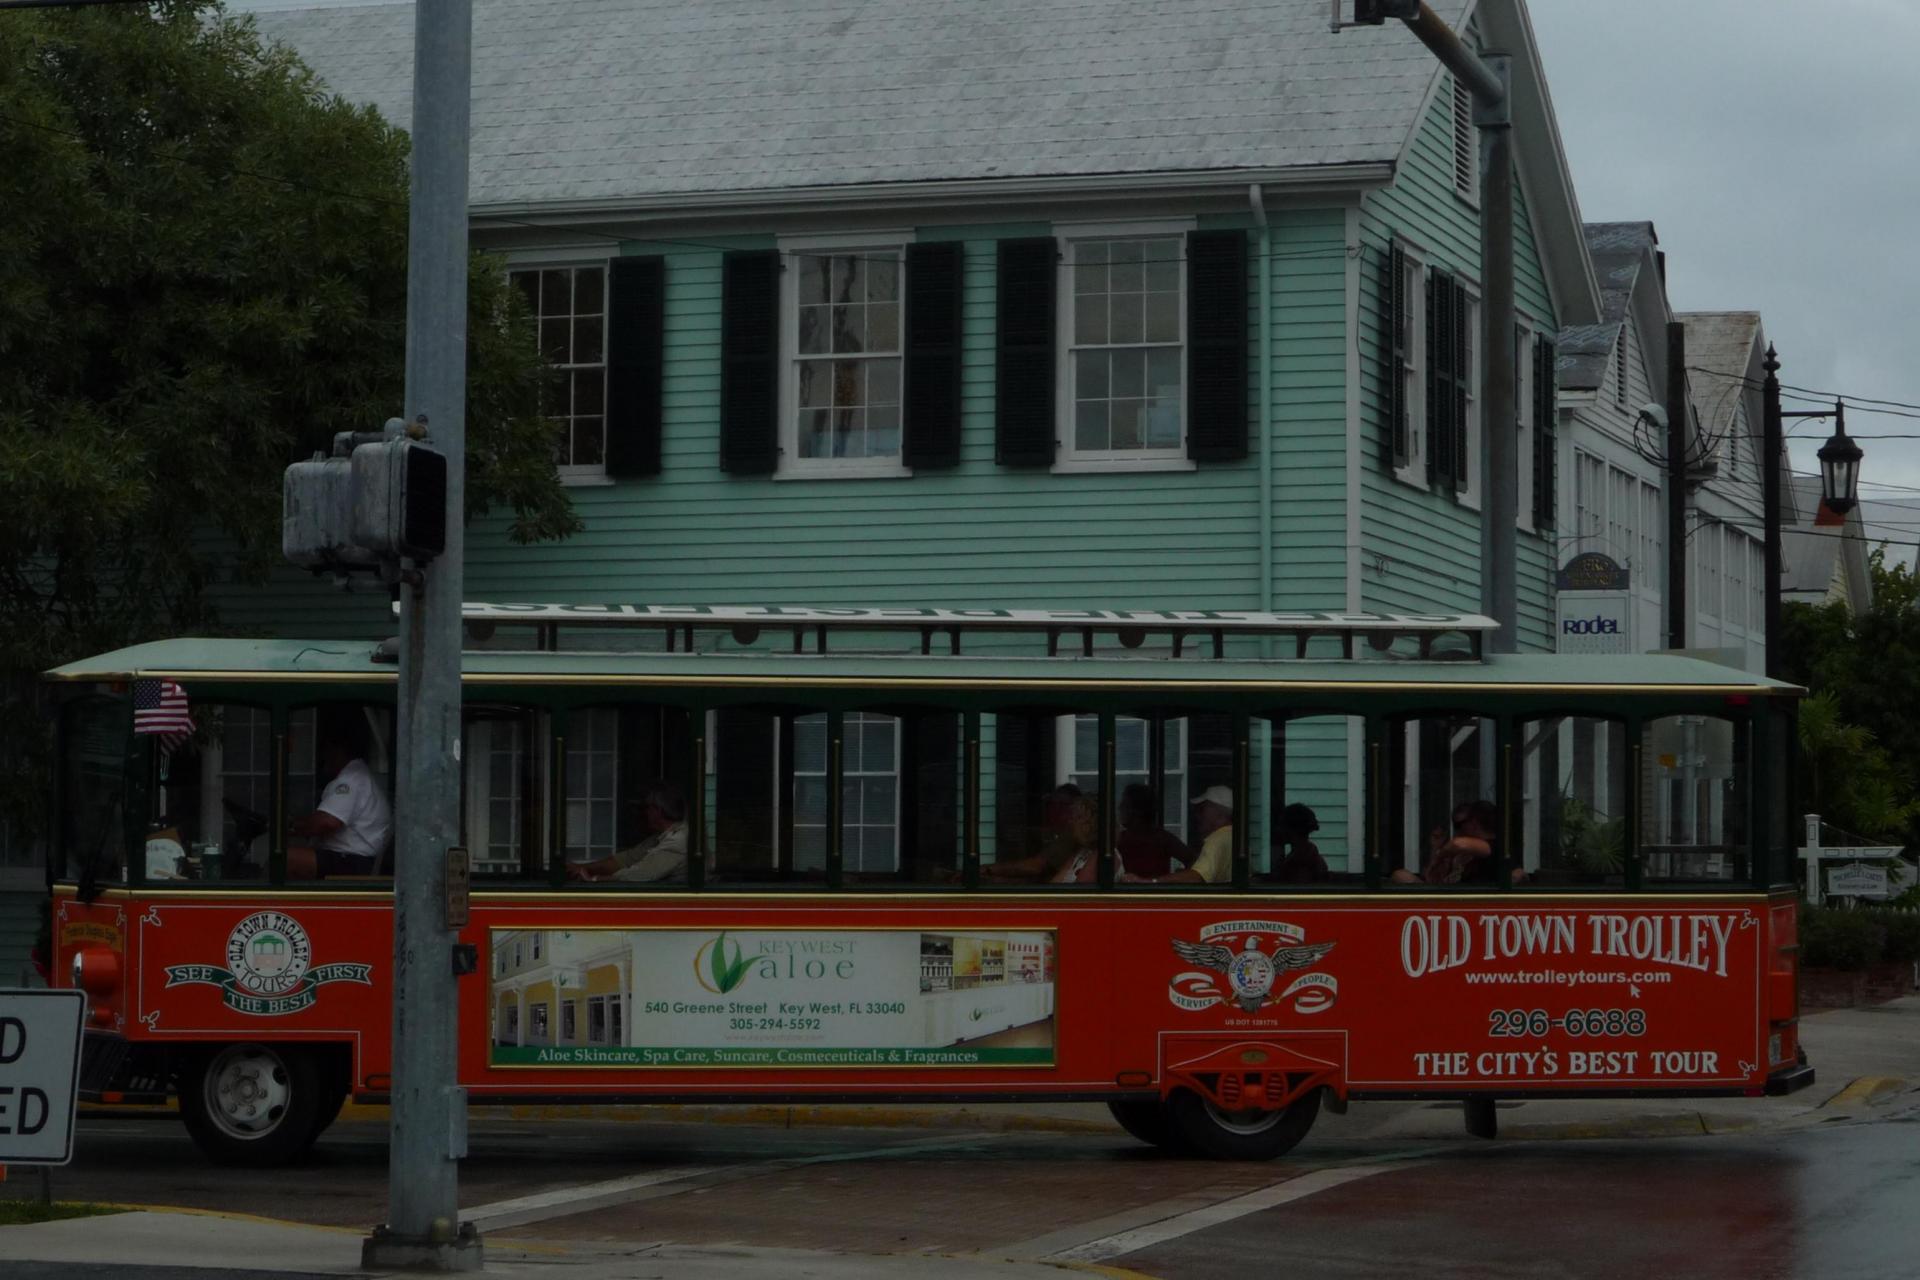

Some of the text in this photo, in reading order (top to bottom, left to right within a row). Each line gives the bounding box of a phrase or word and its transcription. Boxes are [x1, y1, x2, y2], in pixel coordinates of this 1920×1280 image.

[1214, 922, 1289, 934] ENTERTAINMENT
[230, 915, 308, 962] OLD TOWN TROLLEY
[1401, 915, 1737, 977] OLD TOWN TROLLEY
[176, 967, 213, 981] SEE
[316, 966, 366, 980] FIRST
[759, 955, 855, 979] aloe
[240, 968, 298, 992] TOURS
[1298, 975, 1329, 986] PEOPLE
[1465, 968, 1671, 988] www.trolleytours.com
[227, 992, 262, 1012] THE
[645, 1002, 905, 1017] 540 Greene Street Key West, FL 33040
[1176, 997, 1213, 1008] SERVICE
[730, 1019, 821, 1031] 305-294-5592
[1488, 1008, 1646, 1037] 296-6688
[537, 1049, 978, 1065] Aloe Skincare, Spa Care, Suncare, Cosmeceuticals & Fragrances
[1414, 1045, 1719, 1076] THE CITY'S BEST TOUR
